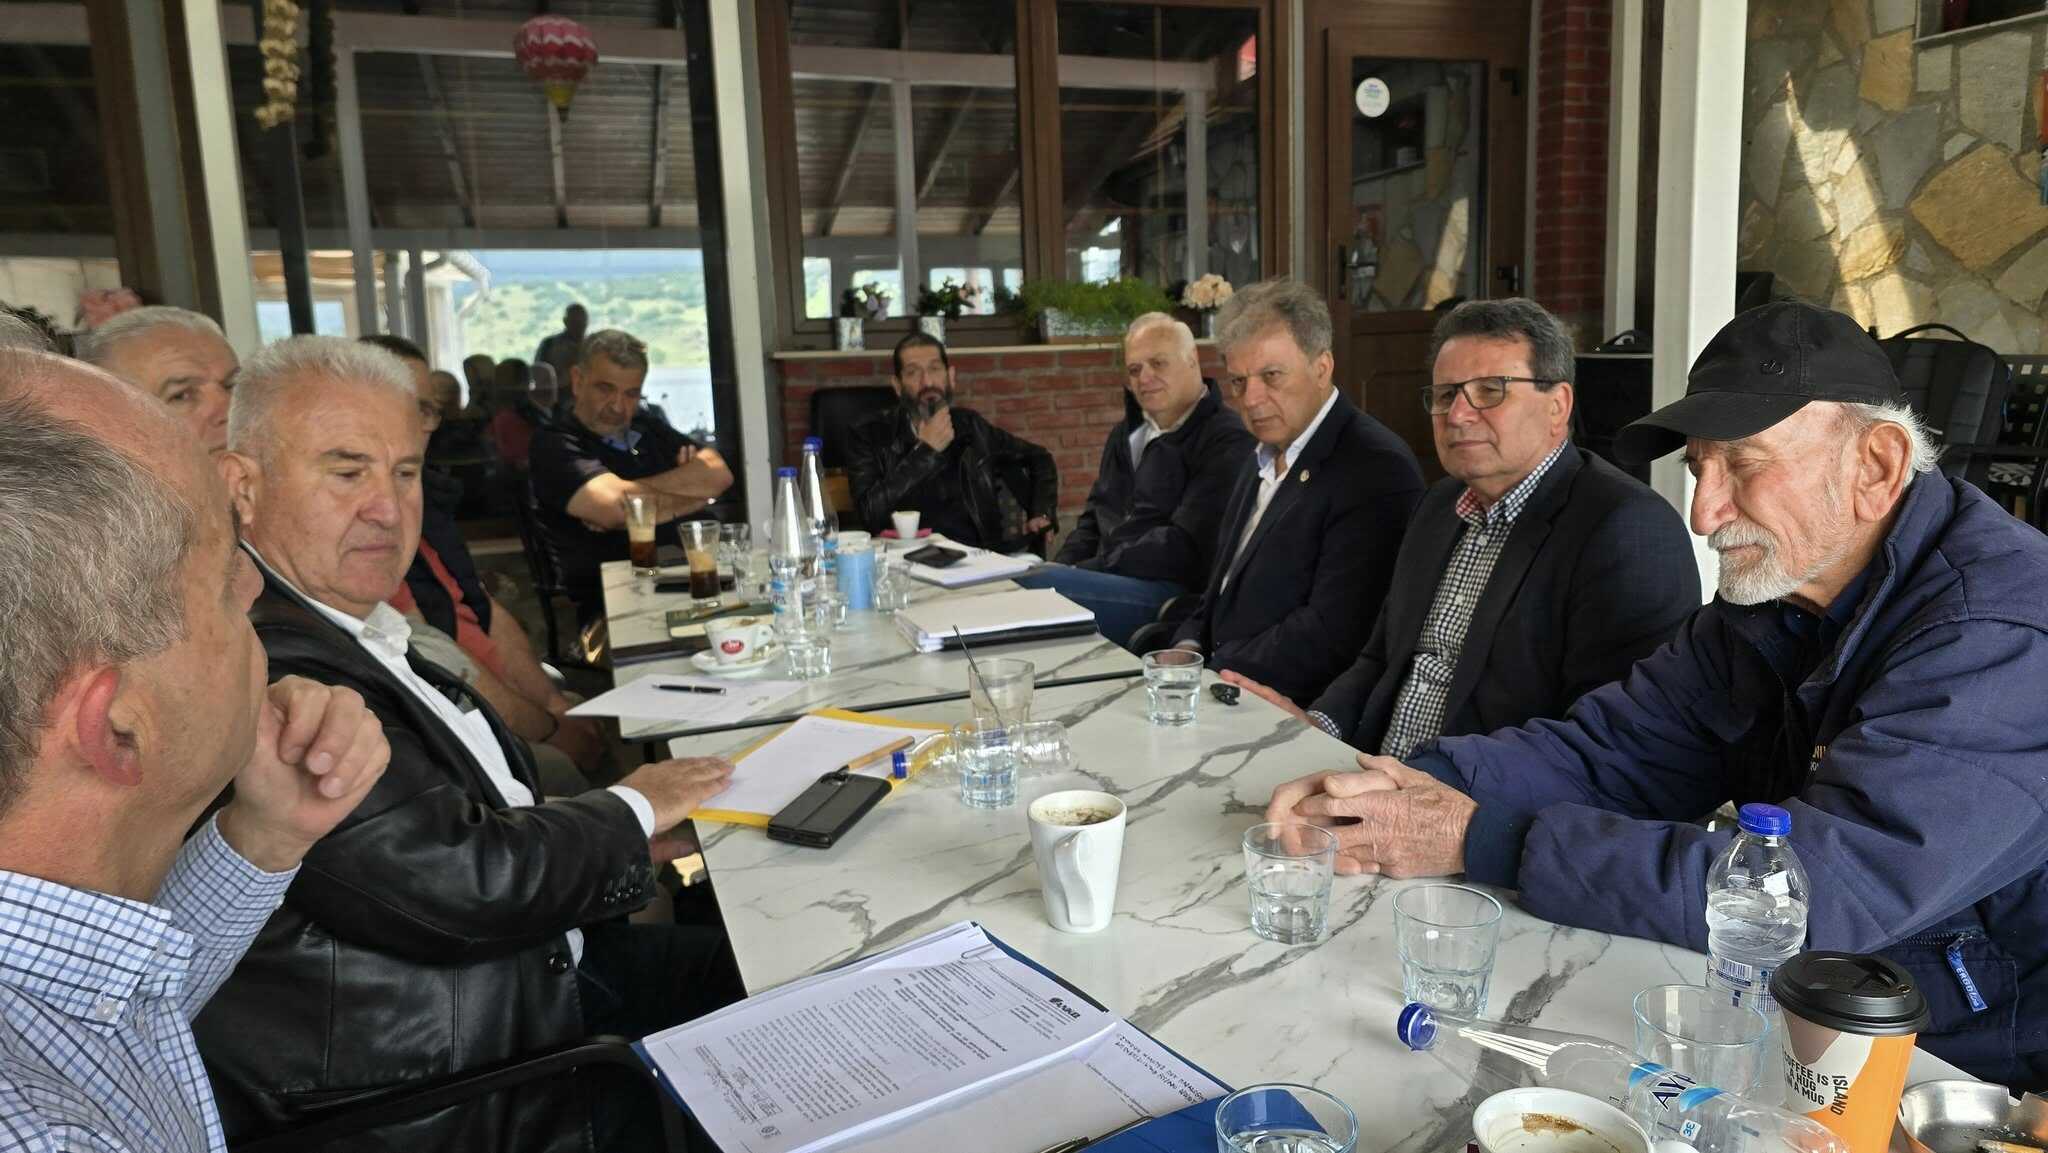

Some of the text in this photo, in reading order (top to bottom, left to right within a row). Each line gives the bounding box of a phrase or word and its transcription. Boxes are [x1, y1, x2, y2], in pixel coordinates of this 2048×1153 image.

[1790, 1068, 1817, 1092] A HUG
[1817, 1073, 1829, 1086] IS
[1794, 1082, 1800, 1094] A
[1802, 1087, 1825, 1106] MUG
[1830, 1075, 1849, 1116] ISLAND
